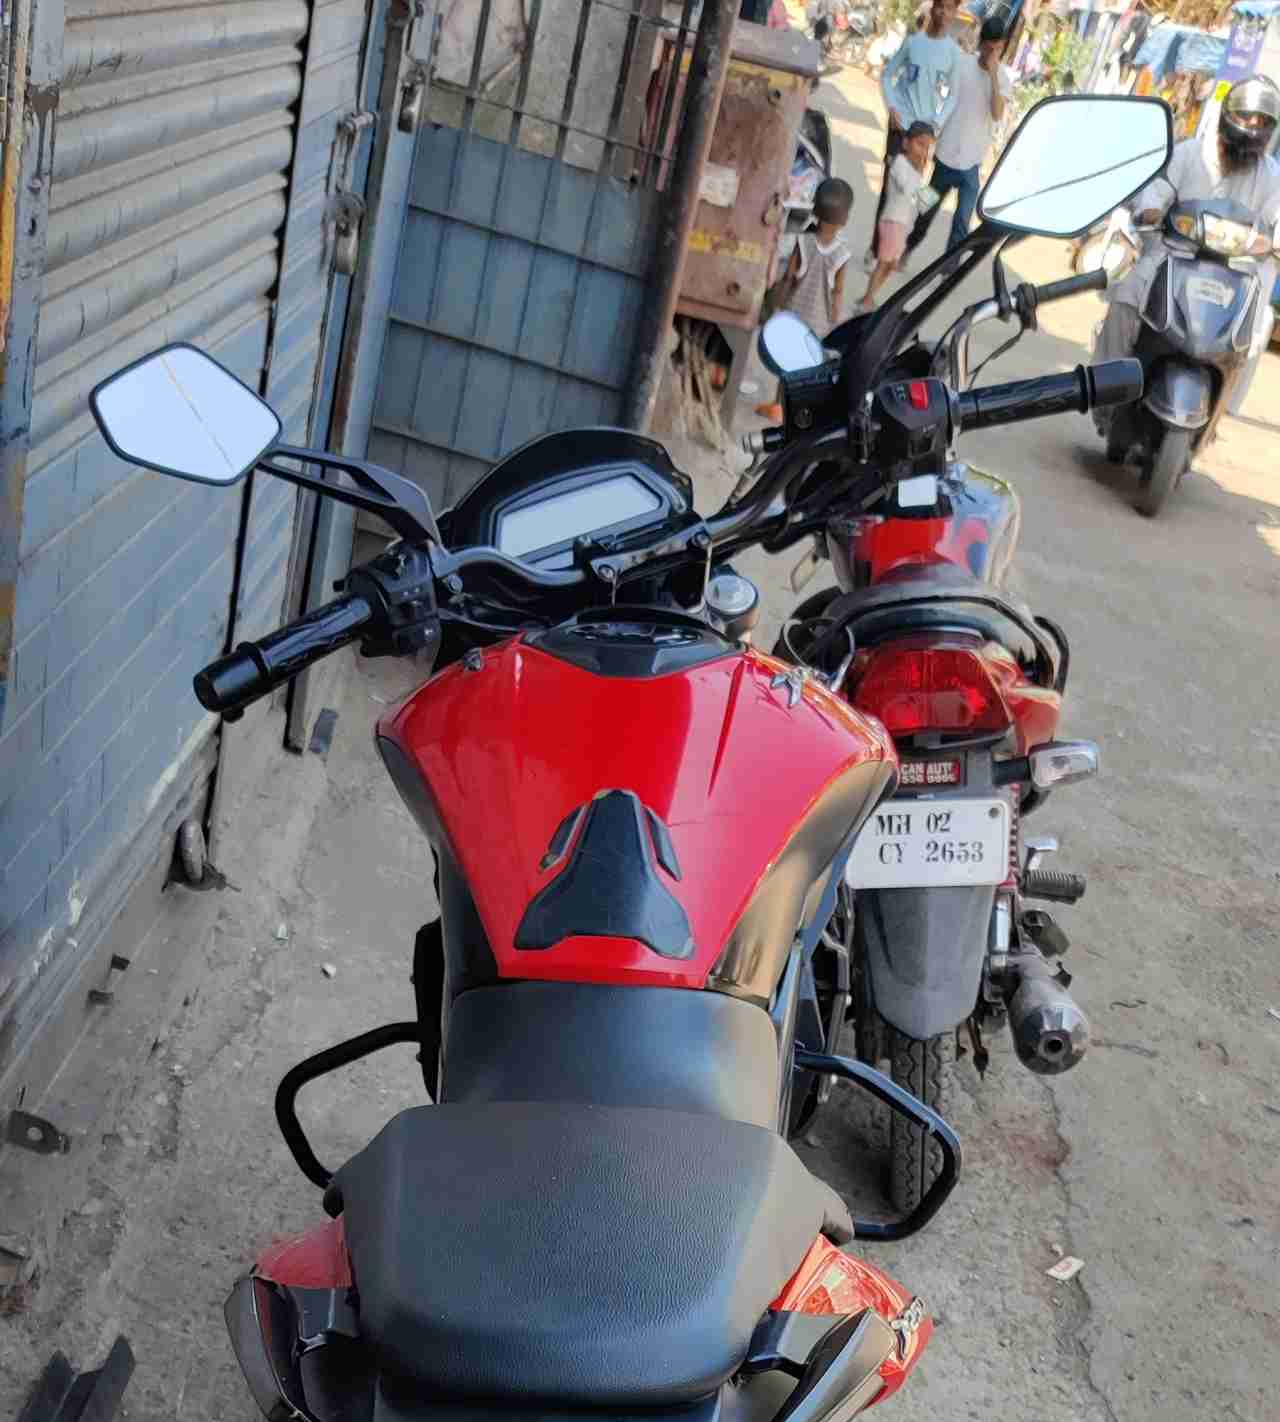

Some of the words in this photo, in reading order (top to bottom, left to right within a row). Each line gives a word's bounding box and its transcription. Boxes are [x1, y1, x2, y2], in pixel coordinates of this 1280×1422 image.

[875, 814, 911, 836] MH
[926, 811, 951, 834] 02
[878, 842, 907, 864] CY
[924, 840, 984, 863] 2653
